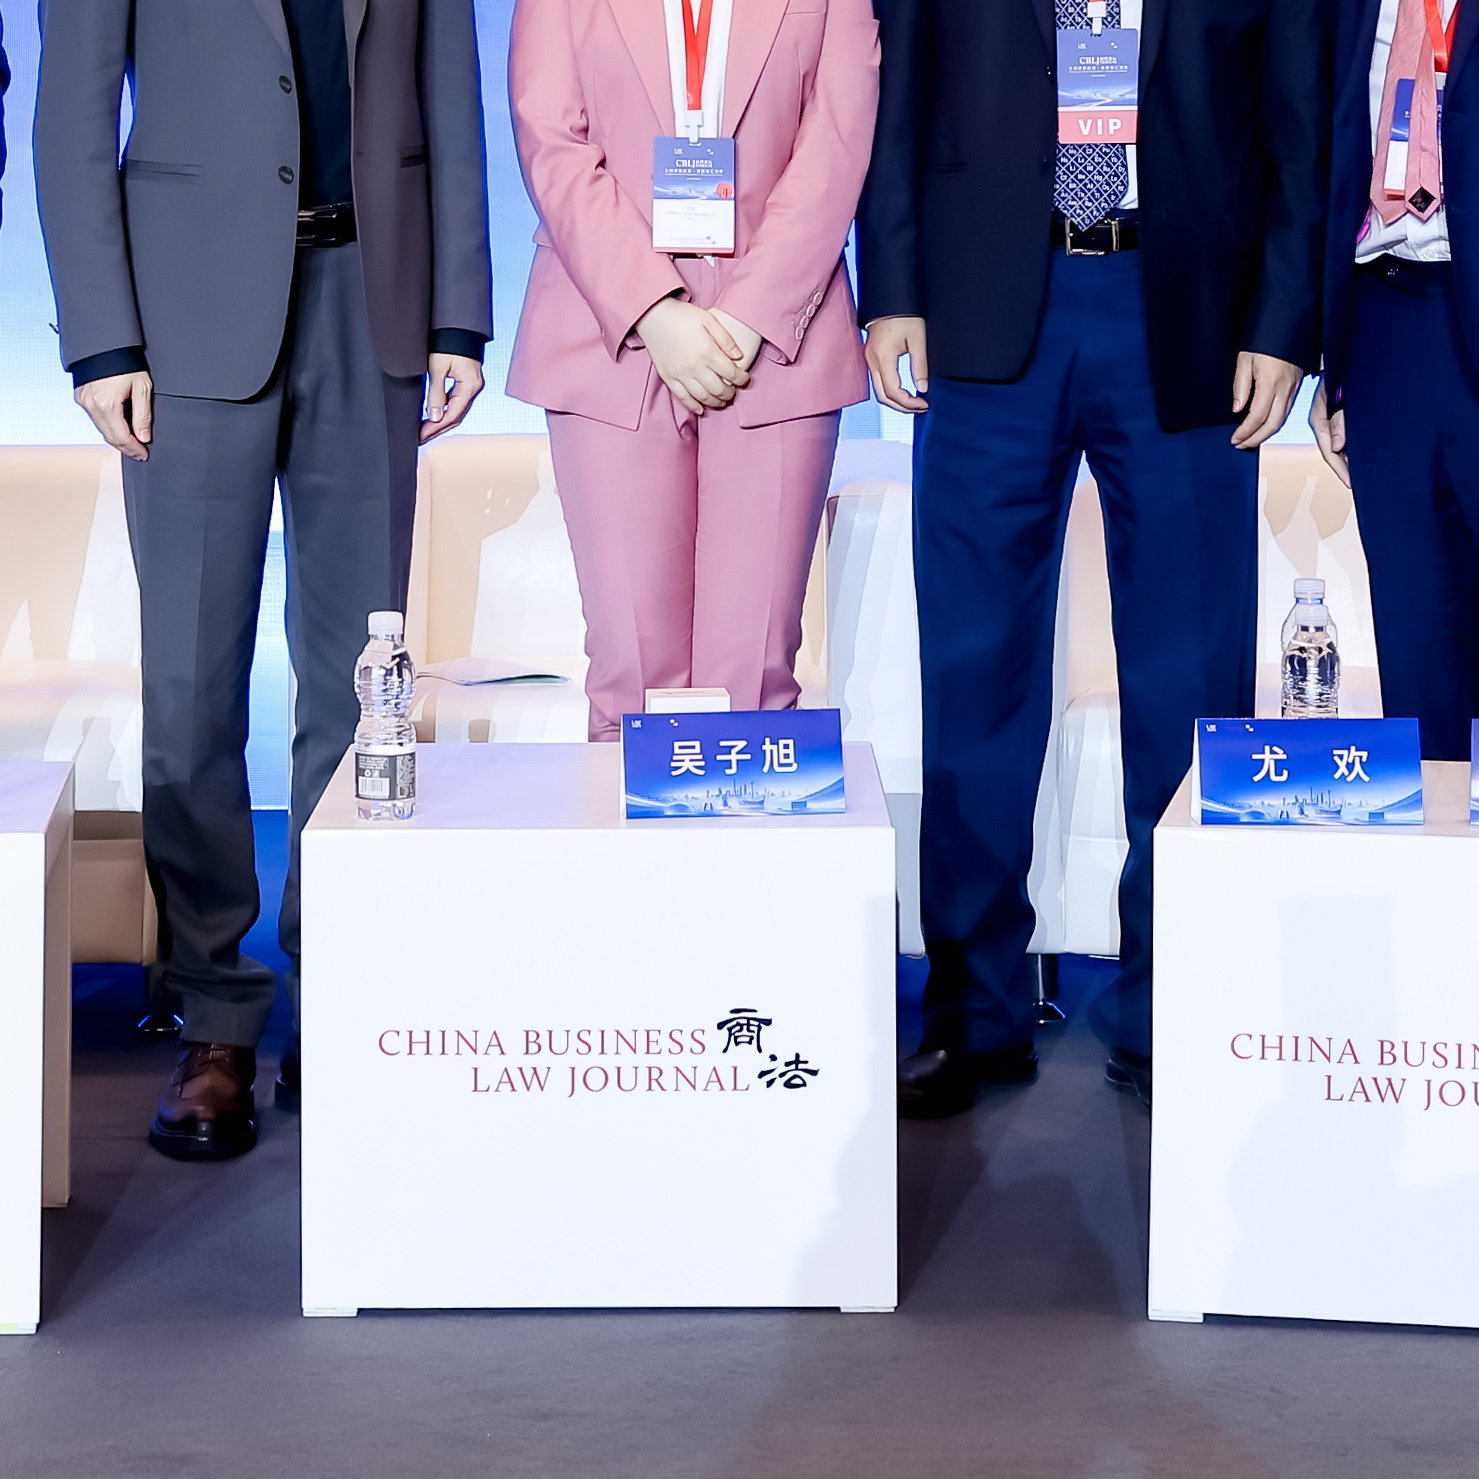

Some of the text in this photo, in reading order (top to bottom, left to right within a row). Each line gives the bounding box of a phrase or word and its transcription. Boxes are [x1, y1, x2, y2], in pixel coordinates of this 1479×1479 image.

[1078, 119, 1122, 136] VIP
[671, 738, 802, 780] 吴子旭
[379, 1029, 705, 1056] CHINA BUSINESS
[1231, 1034, 1360, 1064] CHINA
[472, 1066, 749, 1097] LAW JOURNAL
[1325, 1075, 1406, 1103] LAW
